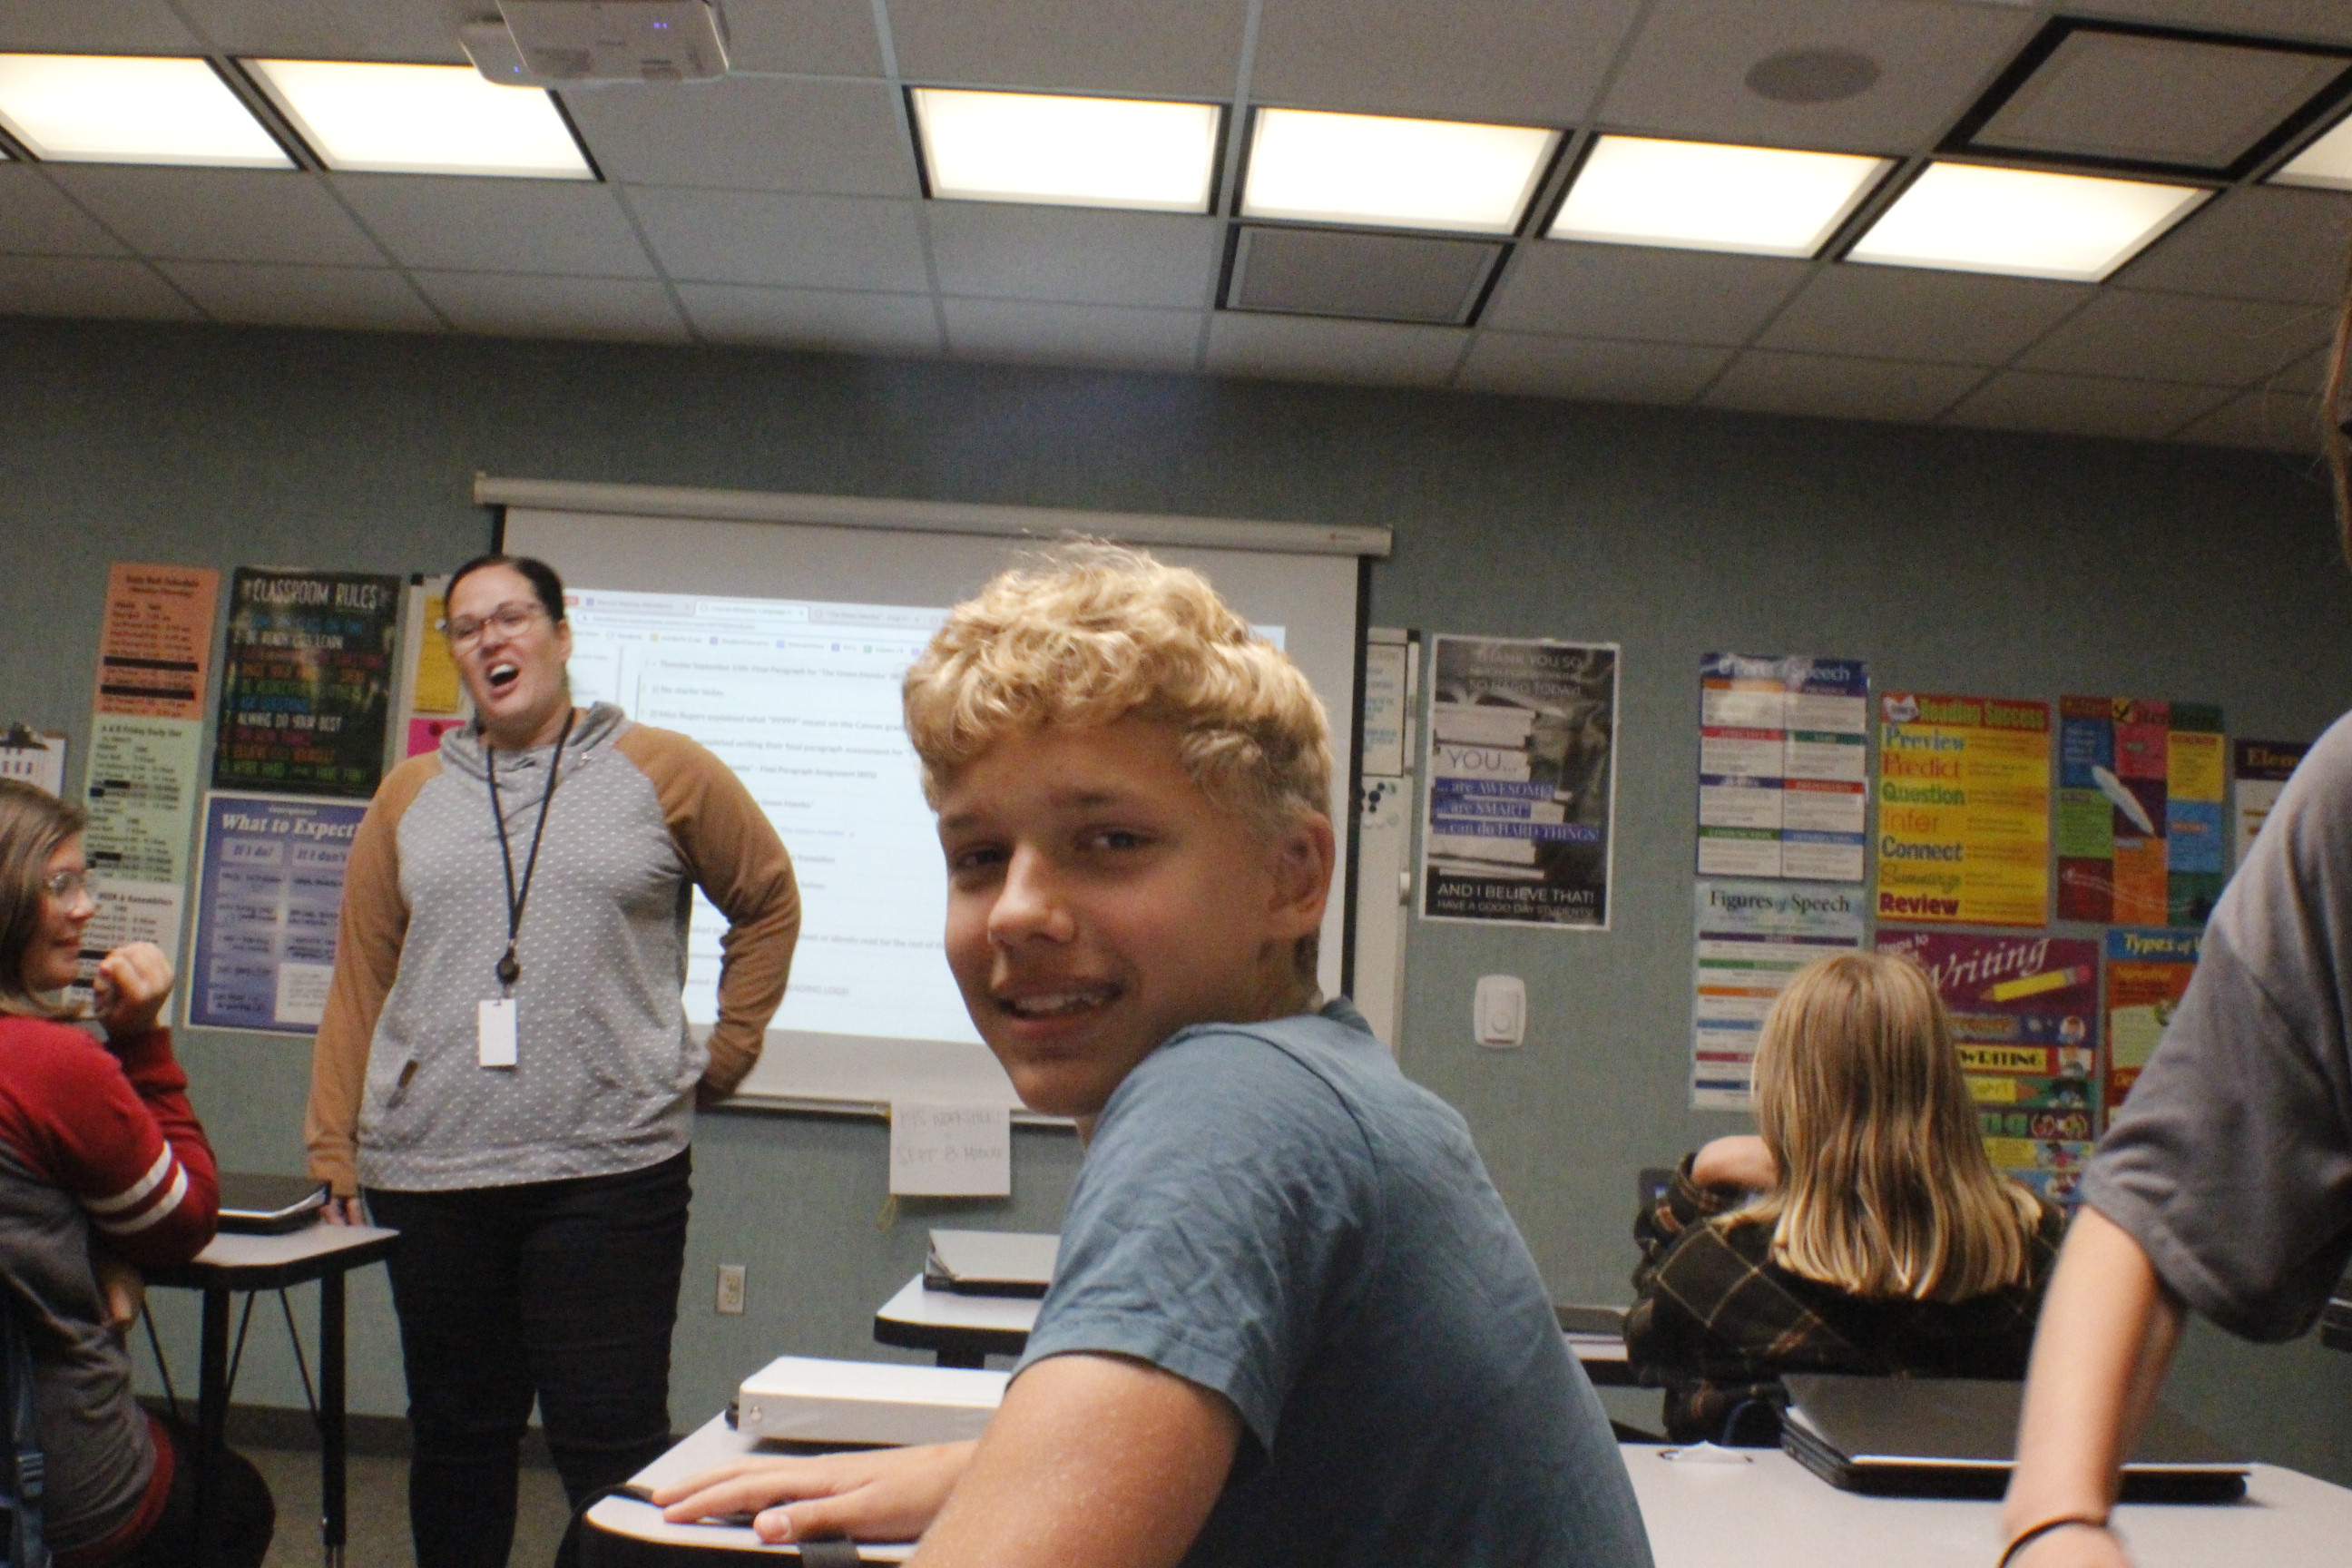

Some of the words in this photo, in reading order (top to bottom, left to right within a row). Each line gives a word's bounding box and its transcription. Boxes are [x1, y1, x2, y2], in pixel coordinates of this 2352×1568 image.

[253, 578, 328, 605] CLASSROOM
[335, 583, 377, 609] RULES
[1885, 724, 1965, 751] Preview
[1884, 752, 1961, 779] Predict
[1451, 781, 1474, 794] are
[1882, 781, 1965, 805] Question
[1450, 802, 1473, 815] are
[1882, 808, 1939, 833] Infer
[222, 814, 268, 832] What
[271, 818, 289, 833] to
[1449, 824, 1475, 836] can
[1477, 823, 1496, 836] do
[1497, 823, 1540, 839] HARD
[1542, 826, 1600, 842] THINGS!
[1882, 835, 1965, 861] Connect
[1437, 882, 1474, 897] AND
[1485, 885, 1548, 903] BELIEVE
[1710, 889, 1773, 912] Figures
[1789, 892, 1850, 915] Speech
[1880, 892, 1960, 916] Review
[2123, 932, 2173, 956] Types
[1959, 1049, 2041, 1067] WRITING
